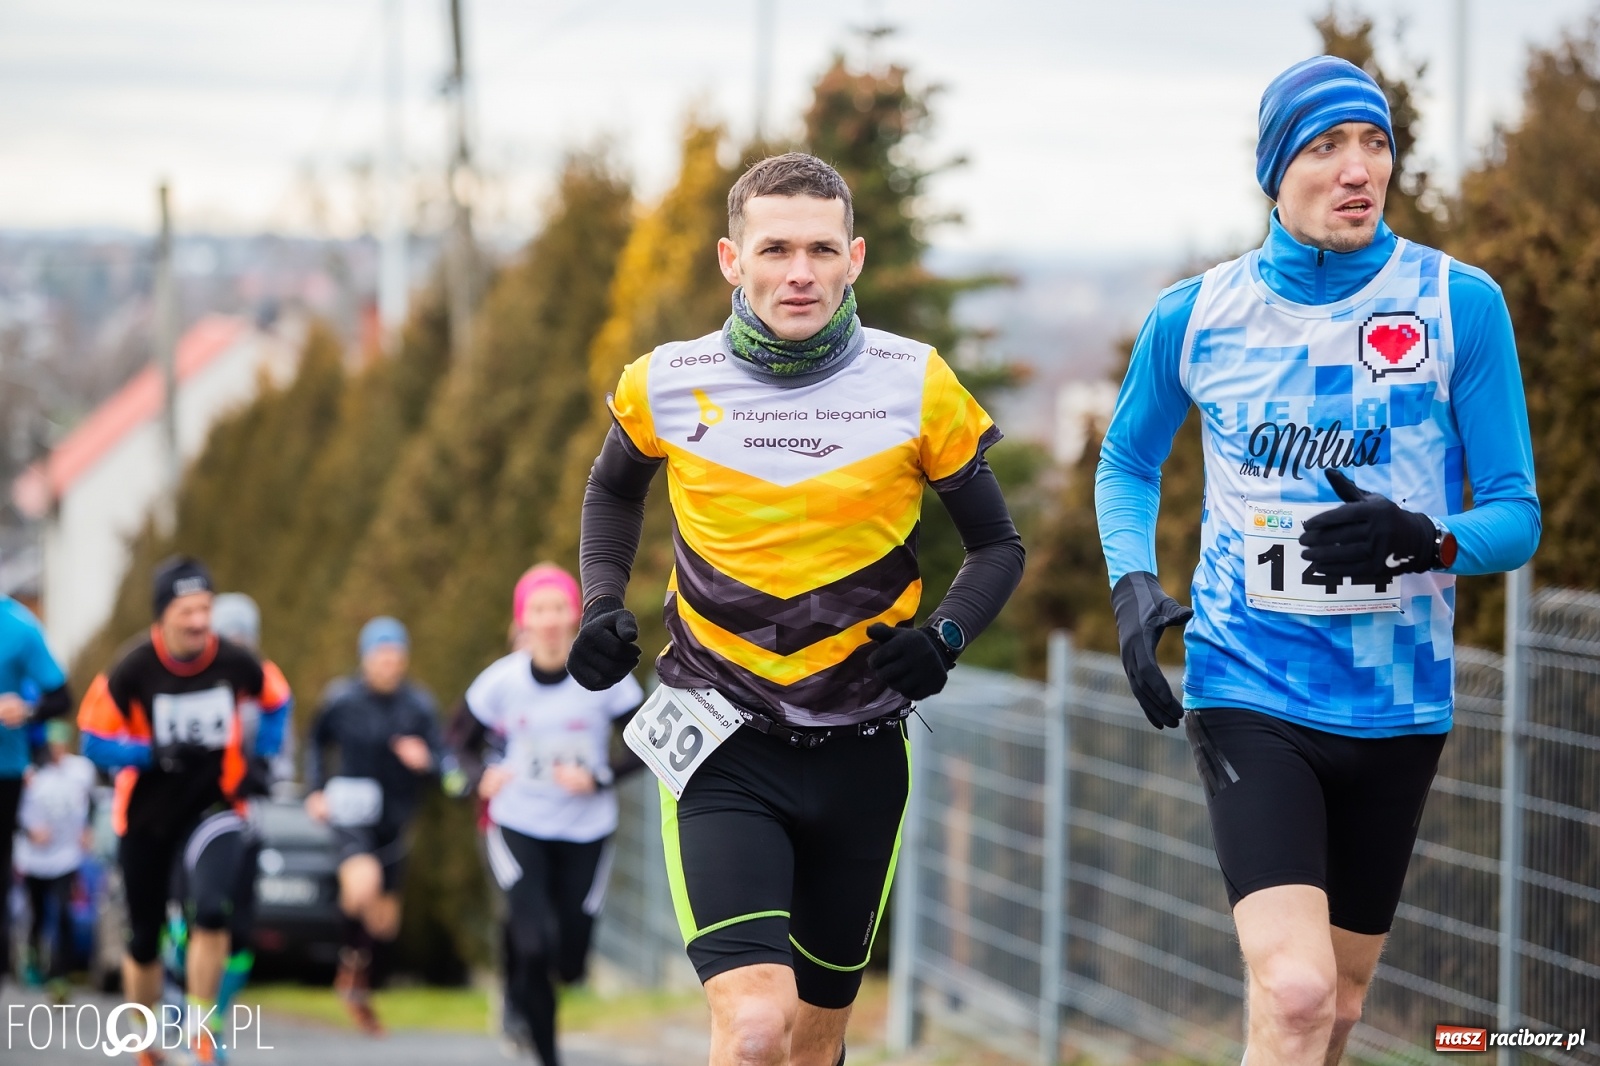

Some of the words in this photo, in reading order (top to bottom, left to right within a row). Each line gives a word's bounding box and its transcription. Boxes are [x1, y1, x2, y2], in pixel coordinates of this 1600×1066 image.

[669, 352, 726, 369] deep
[731, 408, 809, 424] inżynieria
[815, 408, 887, 424] biegania
[743, 434, 822, 451] saucony
[1239, 458, 1261, 478] dla
